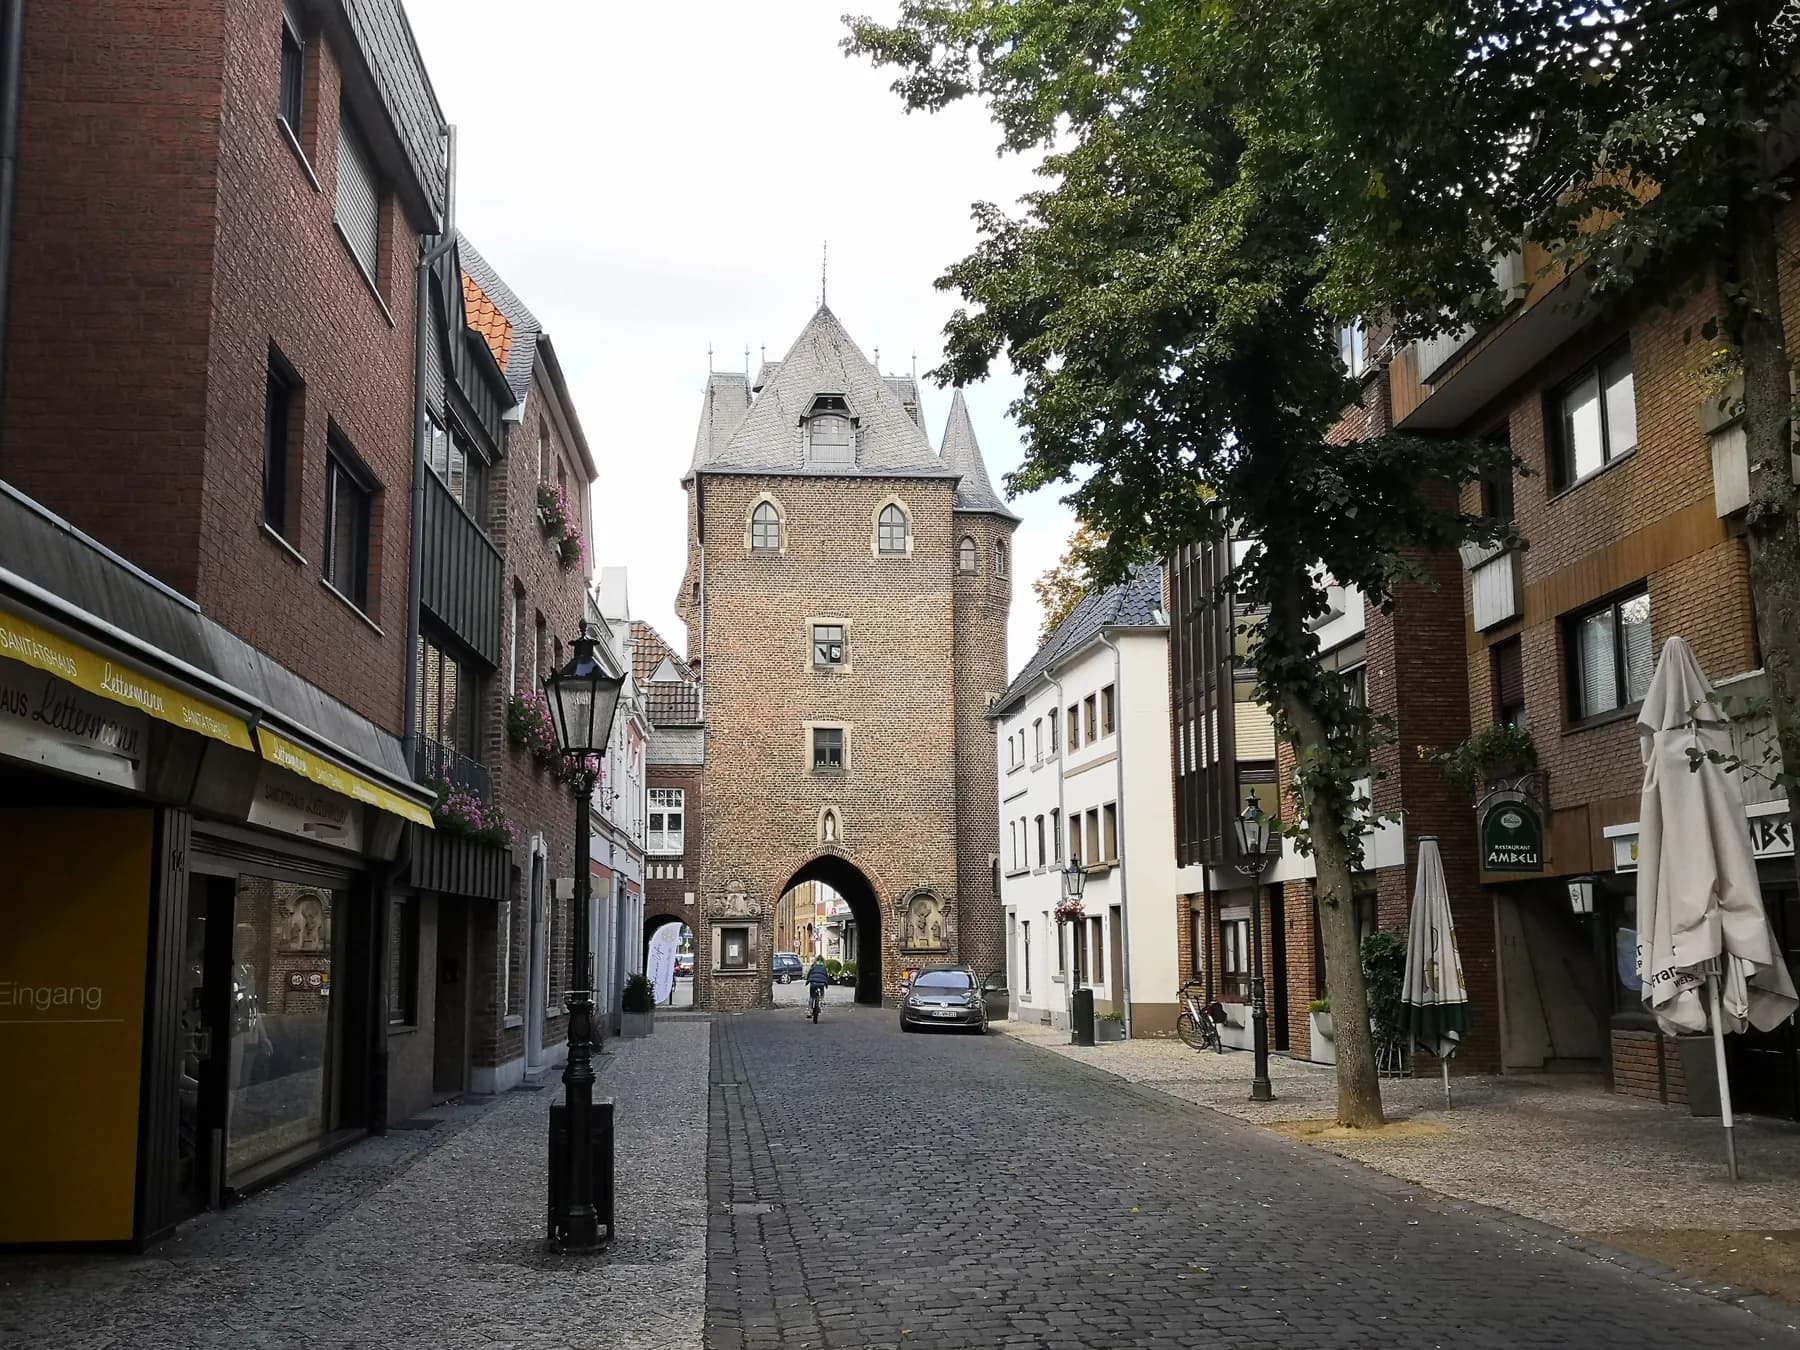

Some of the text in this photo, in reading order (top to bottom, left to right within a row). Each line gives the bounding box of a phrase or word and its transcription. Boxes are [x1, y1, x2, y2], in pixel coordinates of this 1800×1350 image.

[100, 662, 165, 713] Lettermann
[31, 677, 139, 753] Lettermann
[1488, 851, 1537, 863] AMBELI
[0, 981, 102, 1010] Eingang
